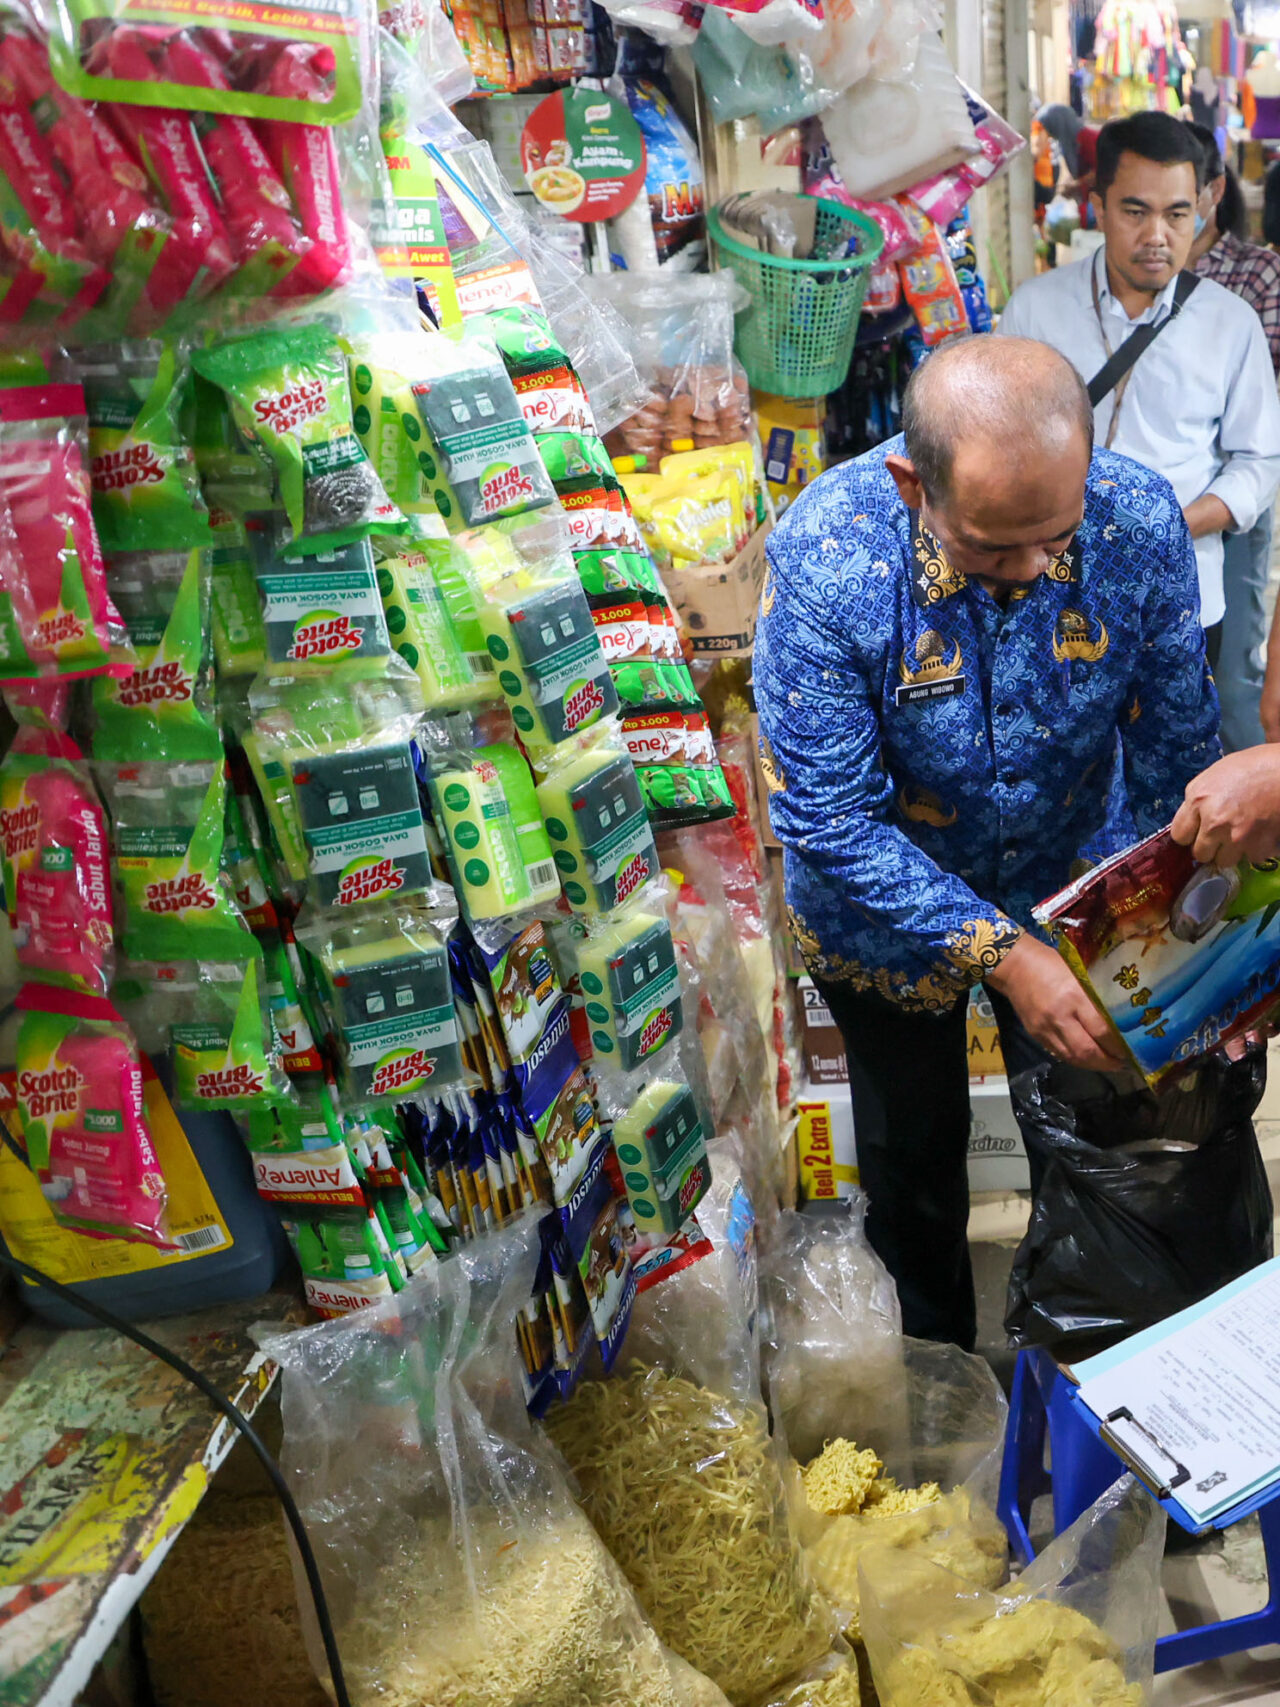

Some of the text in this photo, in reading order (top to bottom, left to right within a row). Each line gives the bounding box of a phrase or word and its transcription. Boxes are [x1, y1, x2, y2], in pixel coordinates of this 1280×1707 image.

[411, 252, 445, 262] Awet
[521, 374, 554, 391] 3.000
[254, 379, 324, 423] Scotch
[270, 395, 327, 434] Brite
[483, 465, 520, 497] Brite
[270, 596, 297, 604] KUAT
[339, 591, 366, 599] DAYA
[601, 607, 632, 624] 3.000
[296, 616, 350, 643] Brite
[708, 637, 737, 651] 220g
[566, 679, 596, 713] Brite
[909, 683, 955, 699] AGUNG WIBOWO
[623, 715, 670, 729] Rp 3.000
[0, 803, 40, 836] Scotch
[5, 828, 38, 858] Brite
[315, 832, 408, 856] DAYA GOSOK KUAT
[87, 863, 108, 912] Sabut
[146, 873, 207, 899] Brite
[342, 857, 394, 891] Brite
[350, 1025, 442, 1051] DAYA GOSOK KUAT
[527, 1012, 570, 1082] Entrasol
[197, 1065, 251, 1085] Brite
[373, 1049, 426, 1080] Brite
[28, 1091, 78, 1118] Brite
[800, 1103, 834, 1198] Beli 2 Extra 1
[269, 1167, 341, 1188] Anlene
[634, 1248, 673, 1278] Zee
